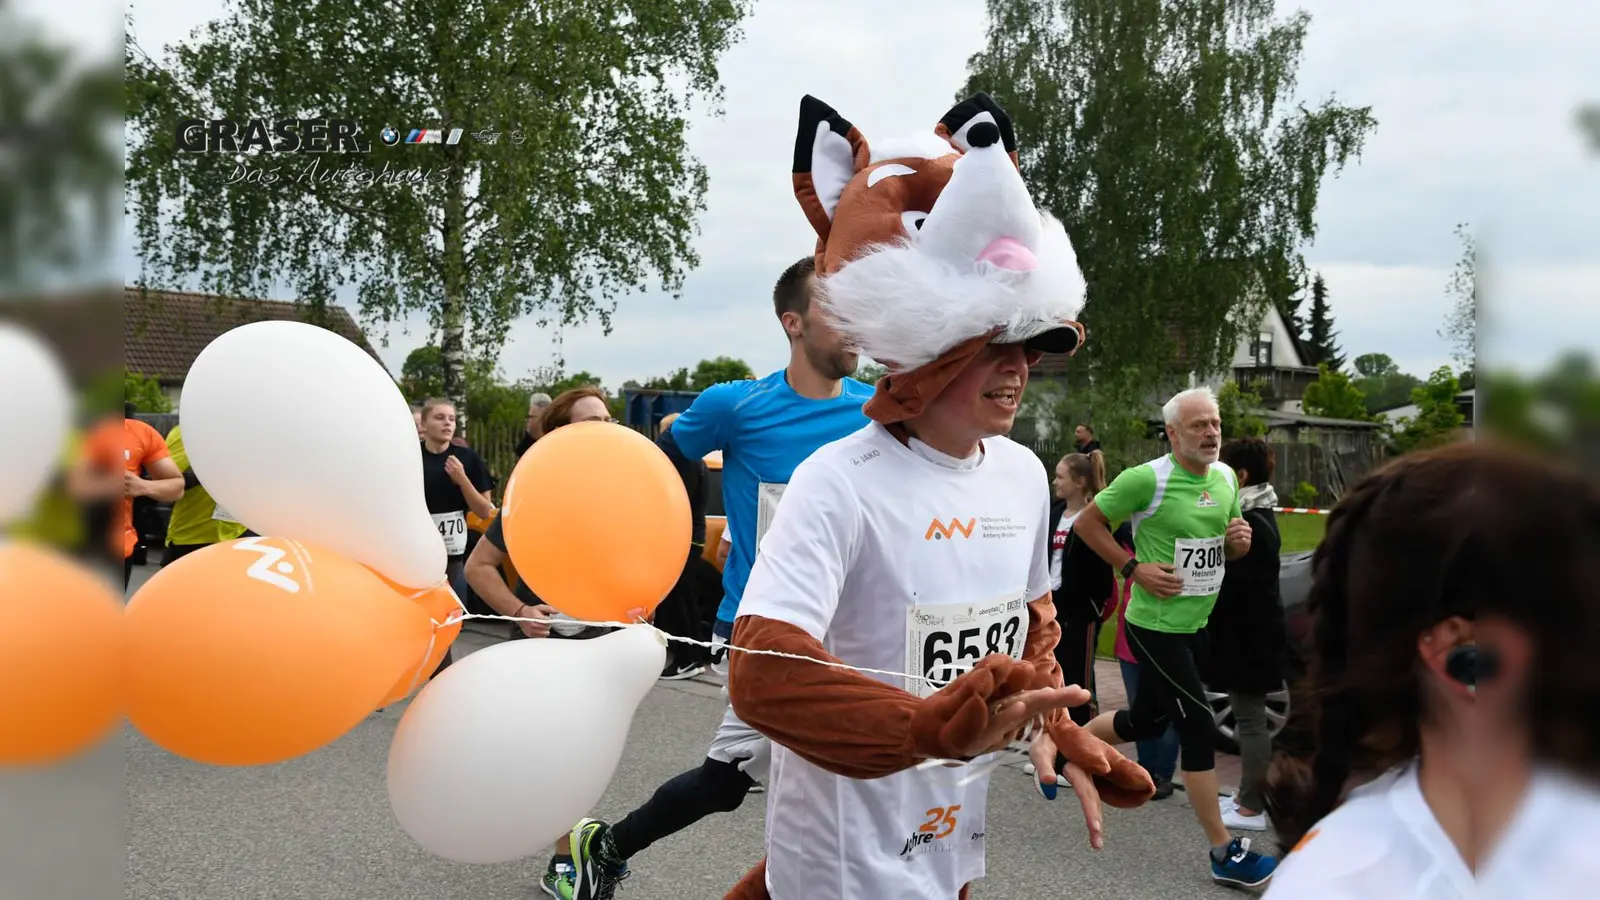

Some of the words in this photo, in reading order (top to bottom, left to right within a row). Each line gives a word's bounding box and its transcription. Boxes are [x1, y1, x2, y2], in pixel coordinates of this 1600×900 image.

[860, 449, 880, 463] JAKO
[1181, 545, 1222, 569] 7308
[1191, 569, 1217, 578] Heinrich
[923, 616, 1020, 689] 6583
[919, 804, 962, 840] 25
[900, 832, 934, 856] Jahre
